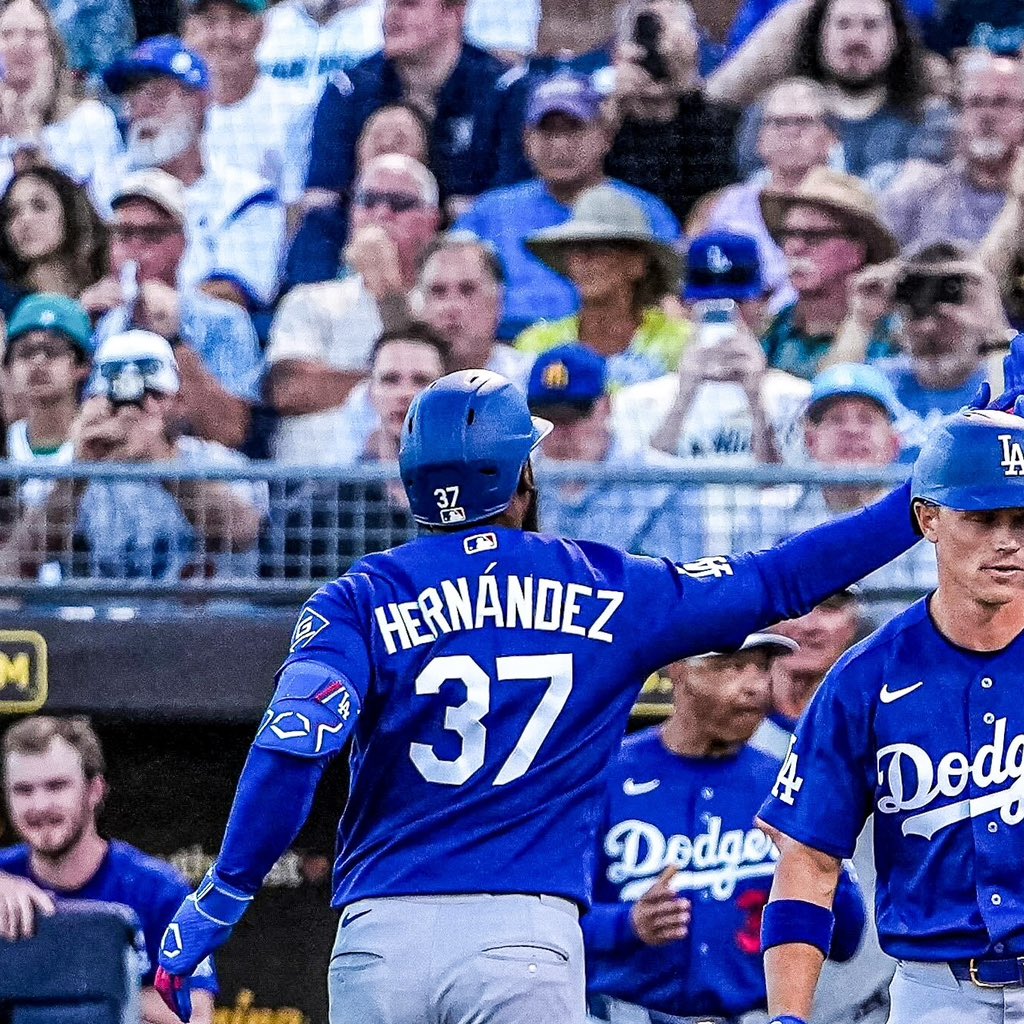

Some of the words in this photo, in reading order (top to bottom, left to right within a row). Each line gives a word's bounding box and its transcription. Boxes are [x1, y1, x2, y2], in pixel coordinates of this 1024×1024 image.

[433, 486, 460, 508] 37
[374, 561, 624, 655] HERNÁNDEZ
[409, 652, 573, 786] 37
[604, 815, 781, 900] Dodge
